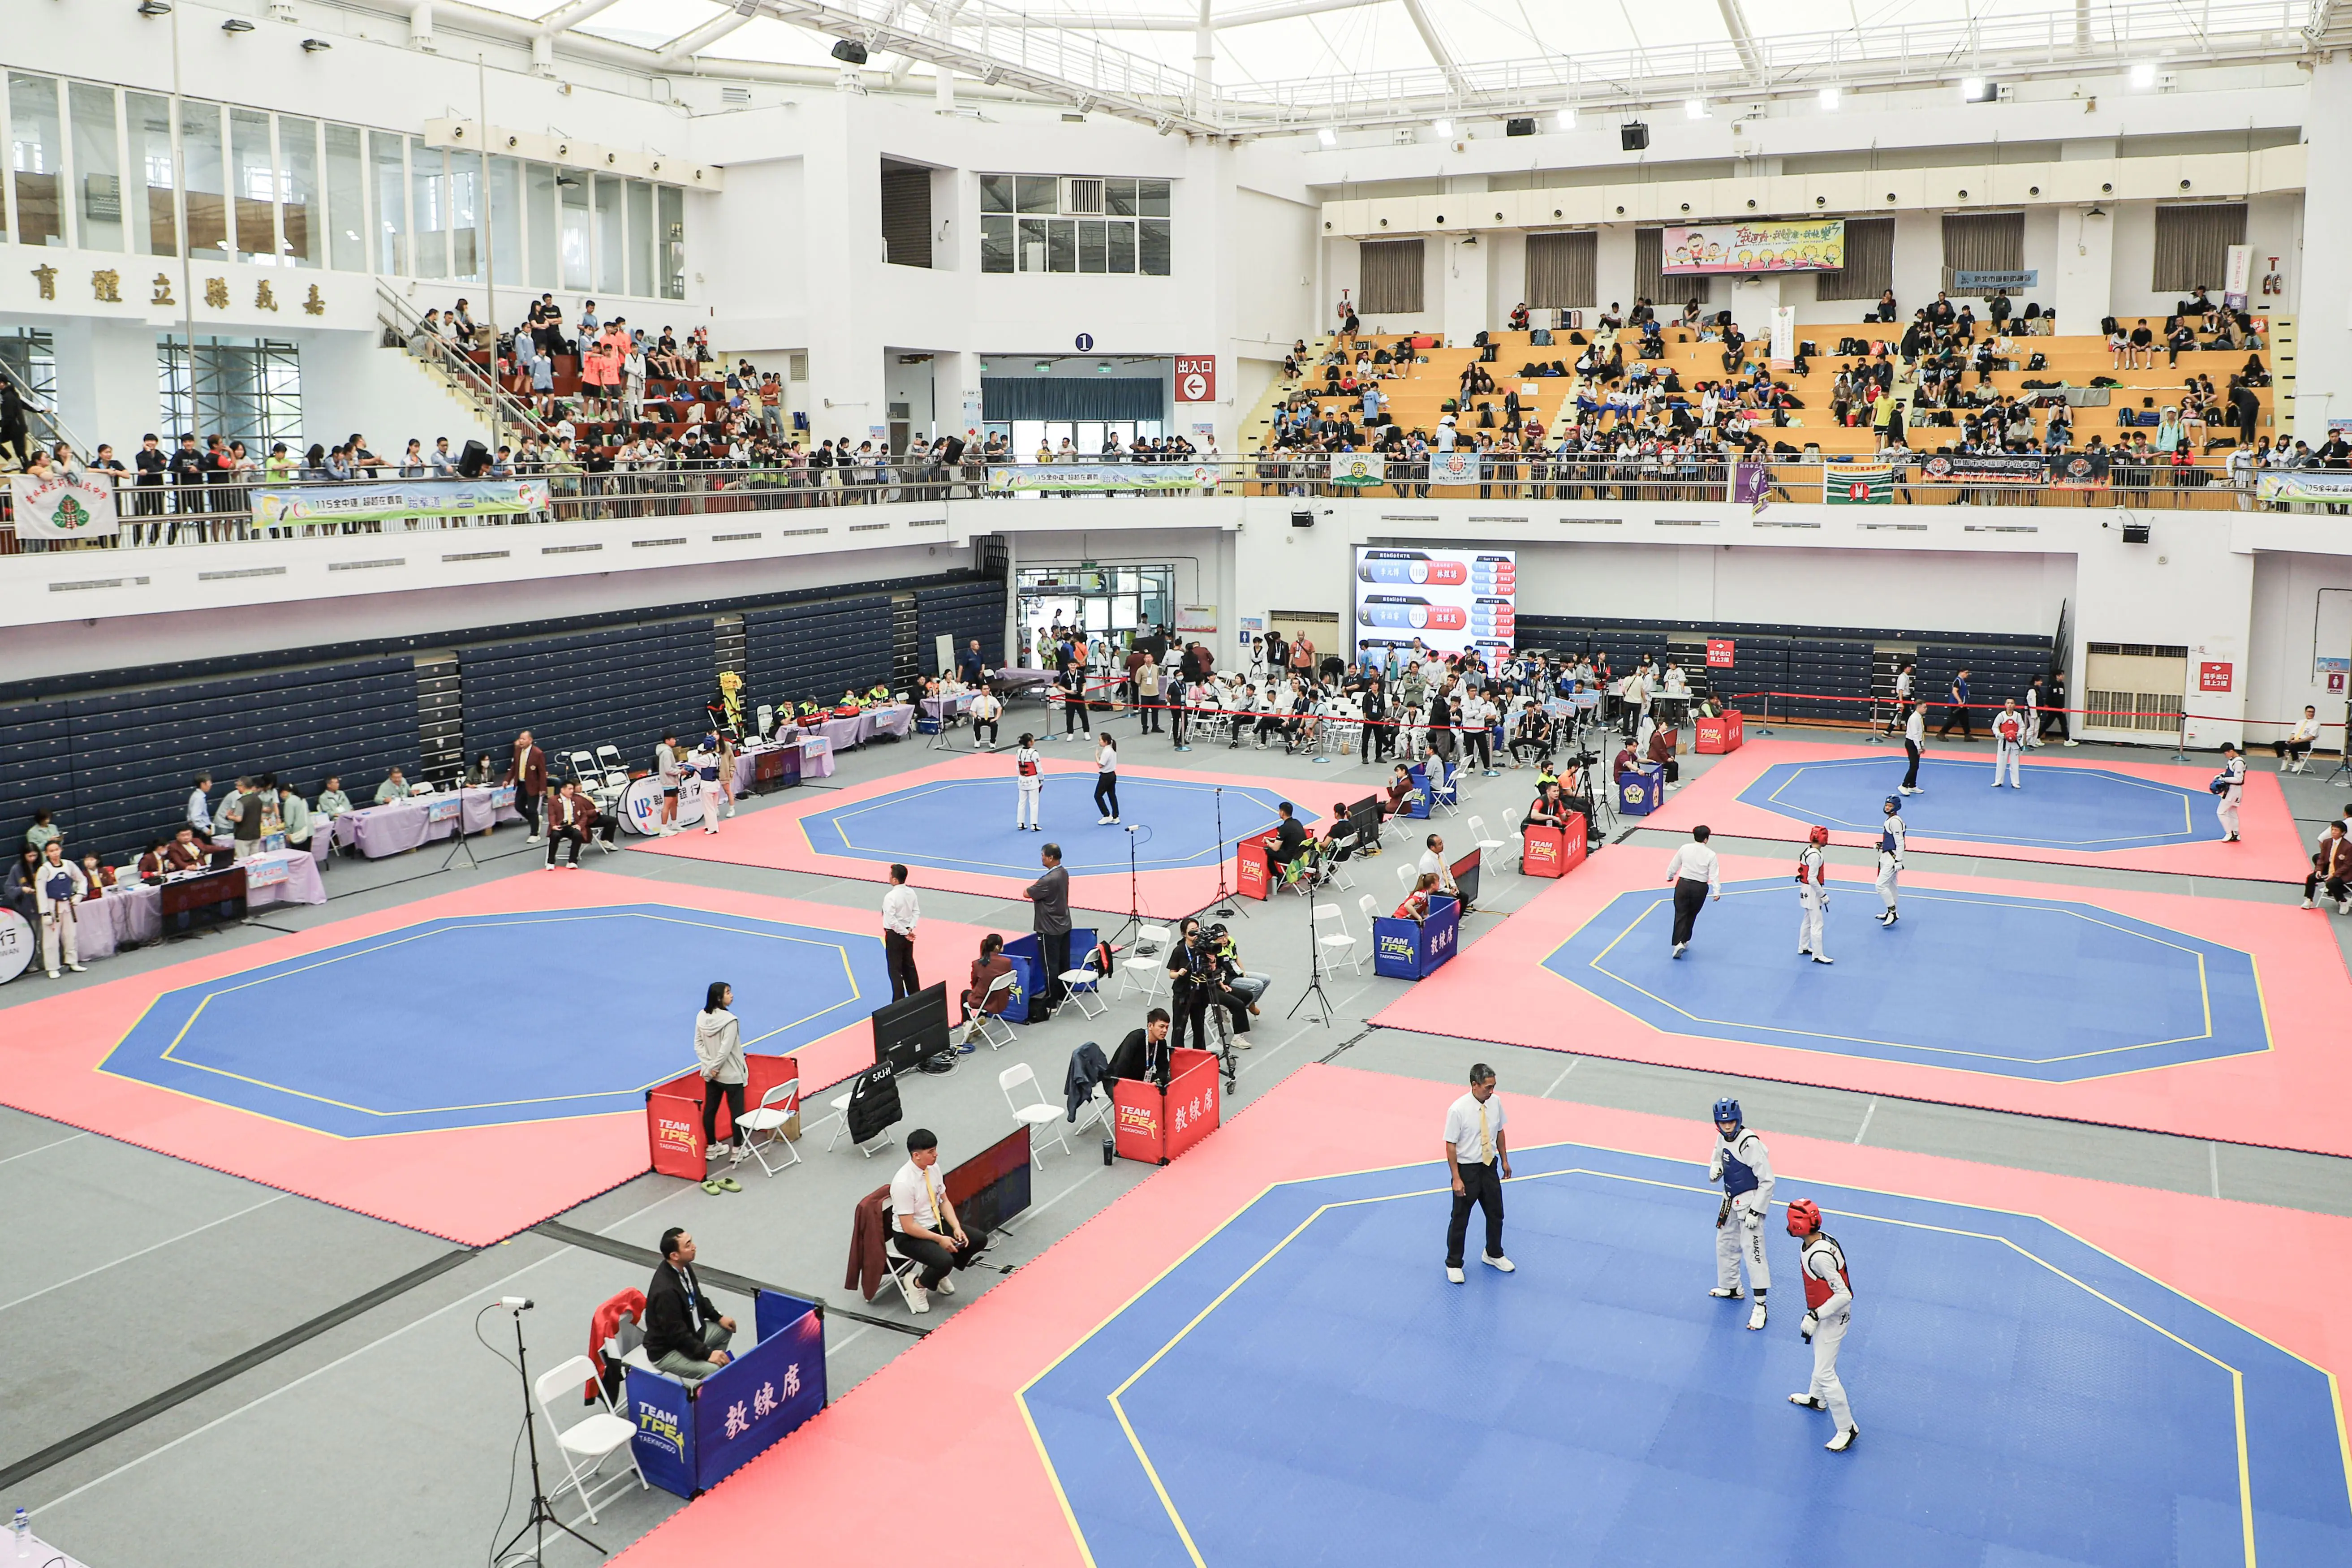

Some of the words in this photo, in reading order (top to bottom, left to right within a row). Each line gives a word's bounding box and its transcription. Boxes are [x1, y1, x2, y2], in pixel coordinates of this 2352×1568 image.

[1080, 334, 1089, 350] 1
[1177, 360, 1212, 374] 出入口
[1102, 474, 1129, 483] 跆拳道
[408, 496, 441, 509] 跆拳道
[1363, 566, 1367, 577] 1
[1363, 610, 1368, 620] 2
[1411, 612, 1425, 621] 2112
[765, 768, 770, 779] 0
[786, 763, 790, 773] 0
[1530, 840, 1553, 848] TEAM
[1530, 846, 1551, 854] TPE
[1242, 859, 1260, 868] TEAM
[1242, 865, 1259, 875] TPE
[1380, 935, 1409, 945] TEAM
[1430, 925, 1453, 956] 教練席
[1380, 942, 1407, 953] TPE
[1120, 1105, 1151, 1118] TEAM
[1175, 1087, 1213, 1133] 教練席
[659, 1119, 690, 1132] TEAM
[1120, 1113, 1150, 1127] TPE
[659, 1127, 689, 1142] TPE
[1120, 1126, 1147, 1136] TAEKWONDO
[659, 1143, 689, 1153] TAEKWONDO
[1753, 1235, 1761, 1264] ASIACUP
[725, 1363, 800, 1440] 教練席
[638, 1401, 678, 1426] TEAM
[639, 1414, 677, 1437] TPE
[638, 1435, 676, 1454] TAEKWONDO
